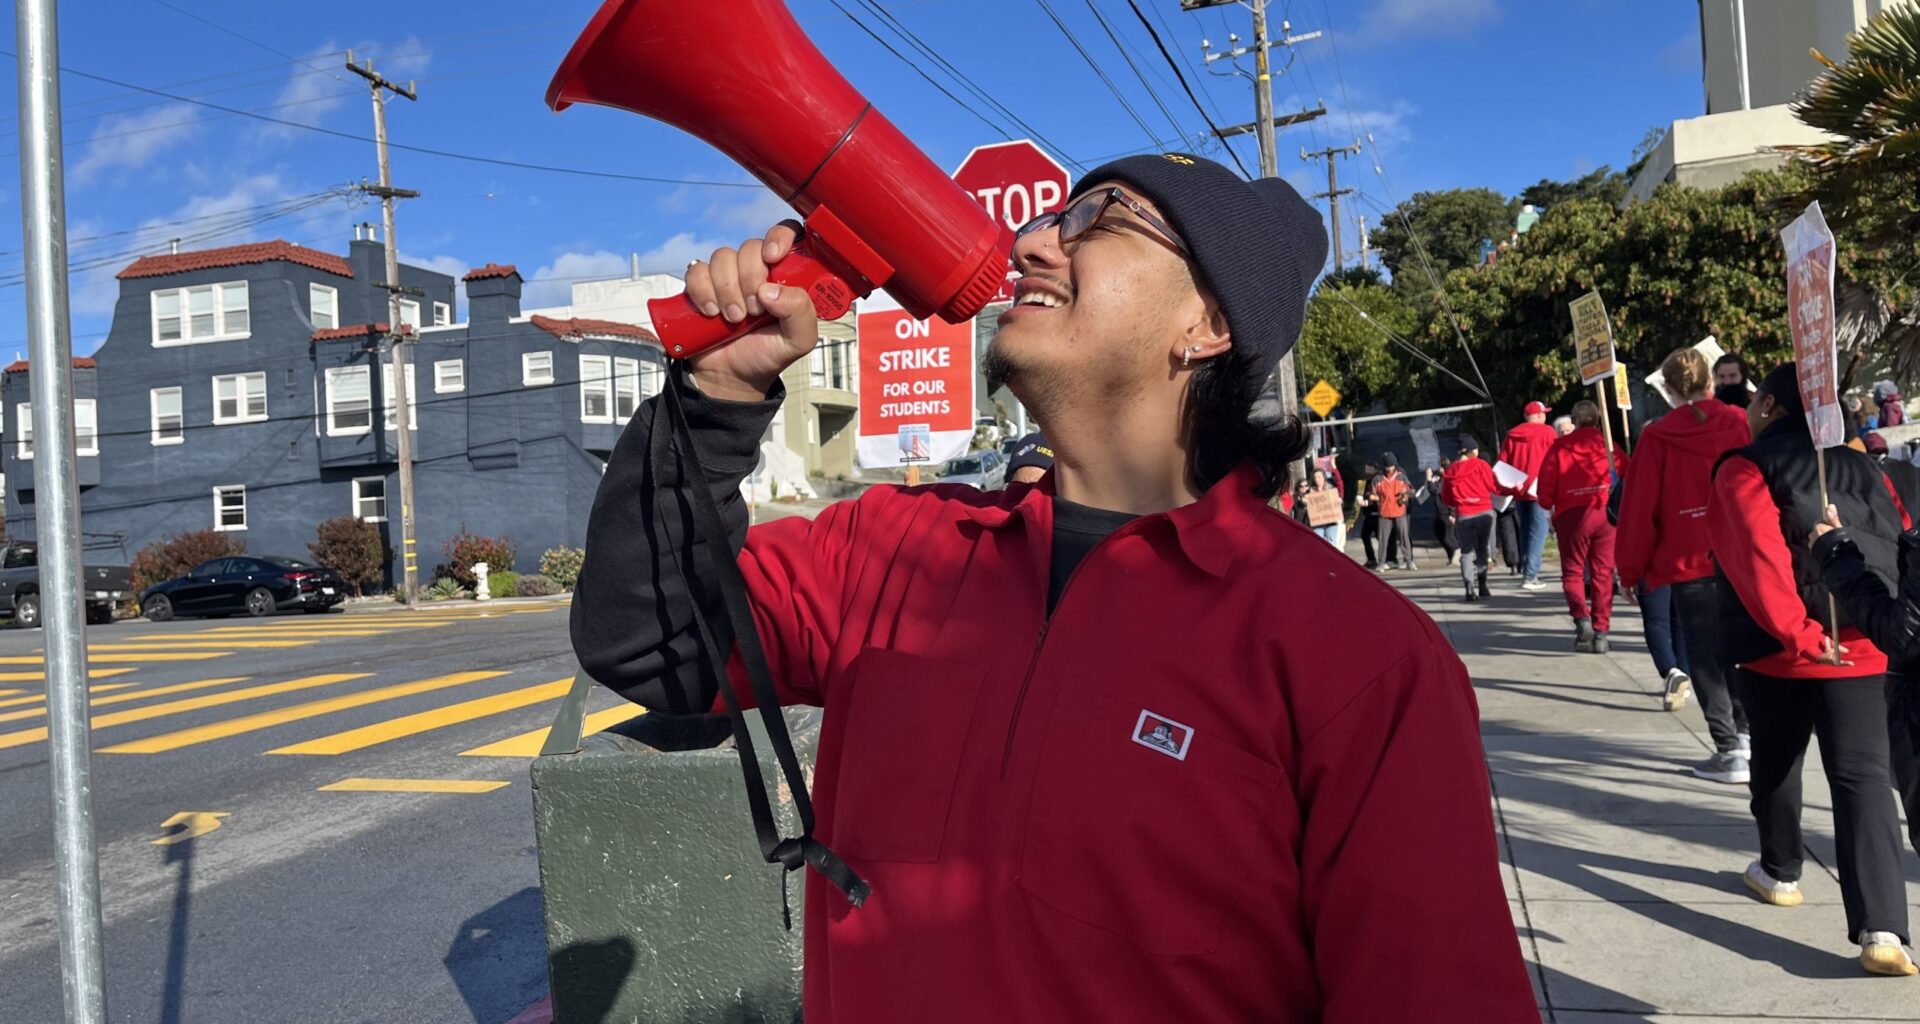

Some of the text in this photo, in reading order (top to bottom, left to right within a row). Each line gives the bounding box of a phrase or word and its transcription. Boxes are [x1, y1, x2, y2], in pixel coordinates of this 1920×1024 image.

[895, 318, 930, 339] ON
[879, 347, 950, 372] STRIKE
[883, 380, 946, 397] FOR OUR
[880, 400, 950, 417] STUDENTS
